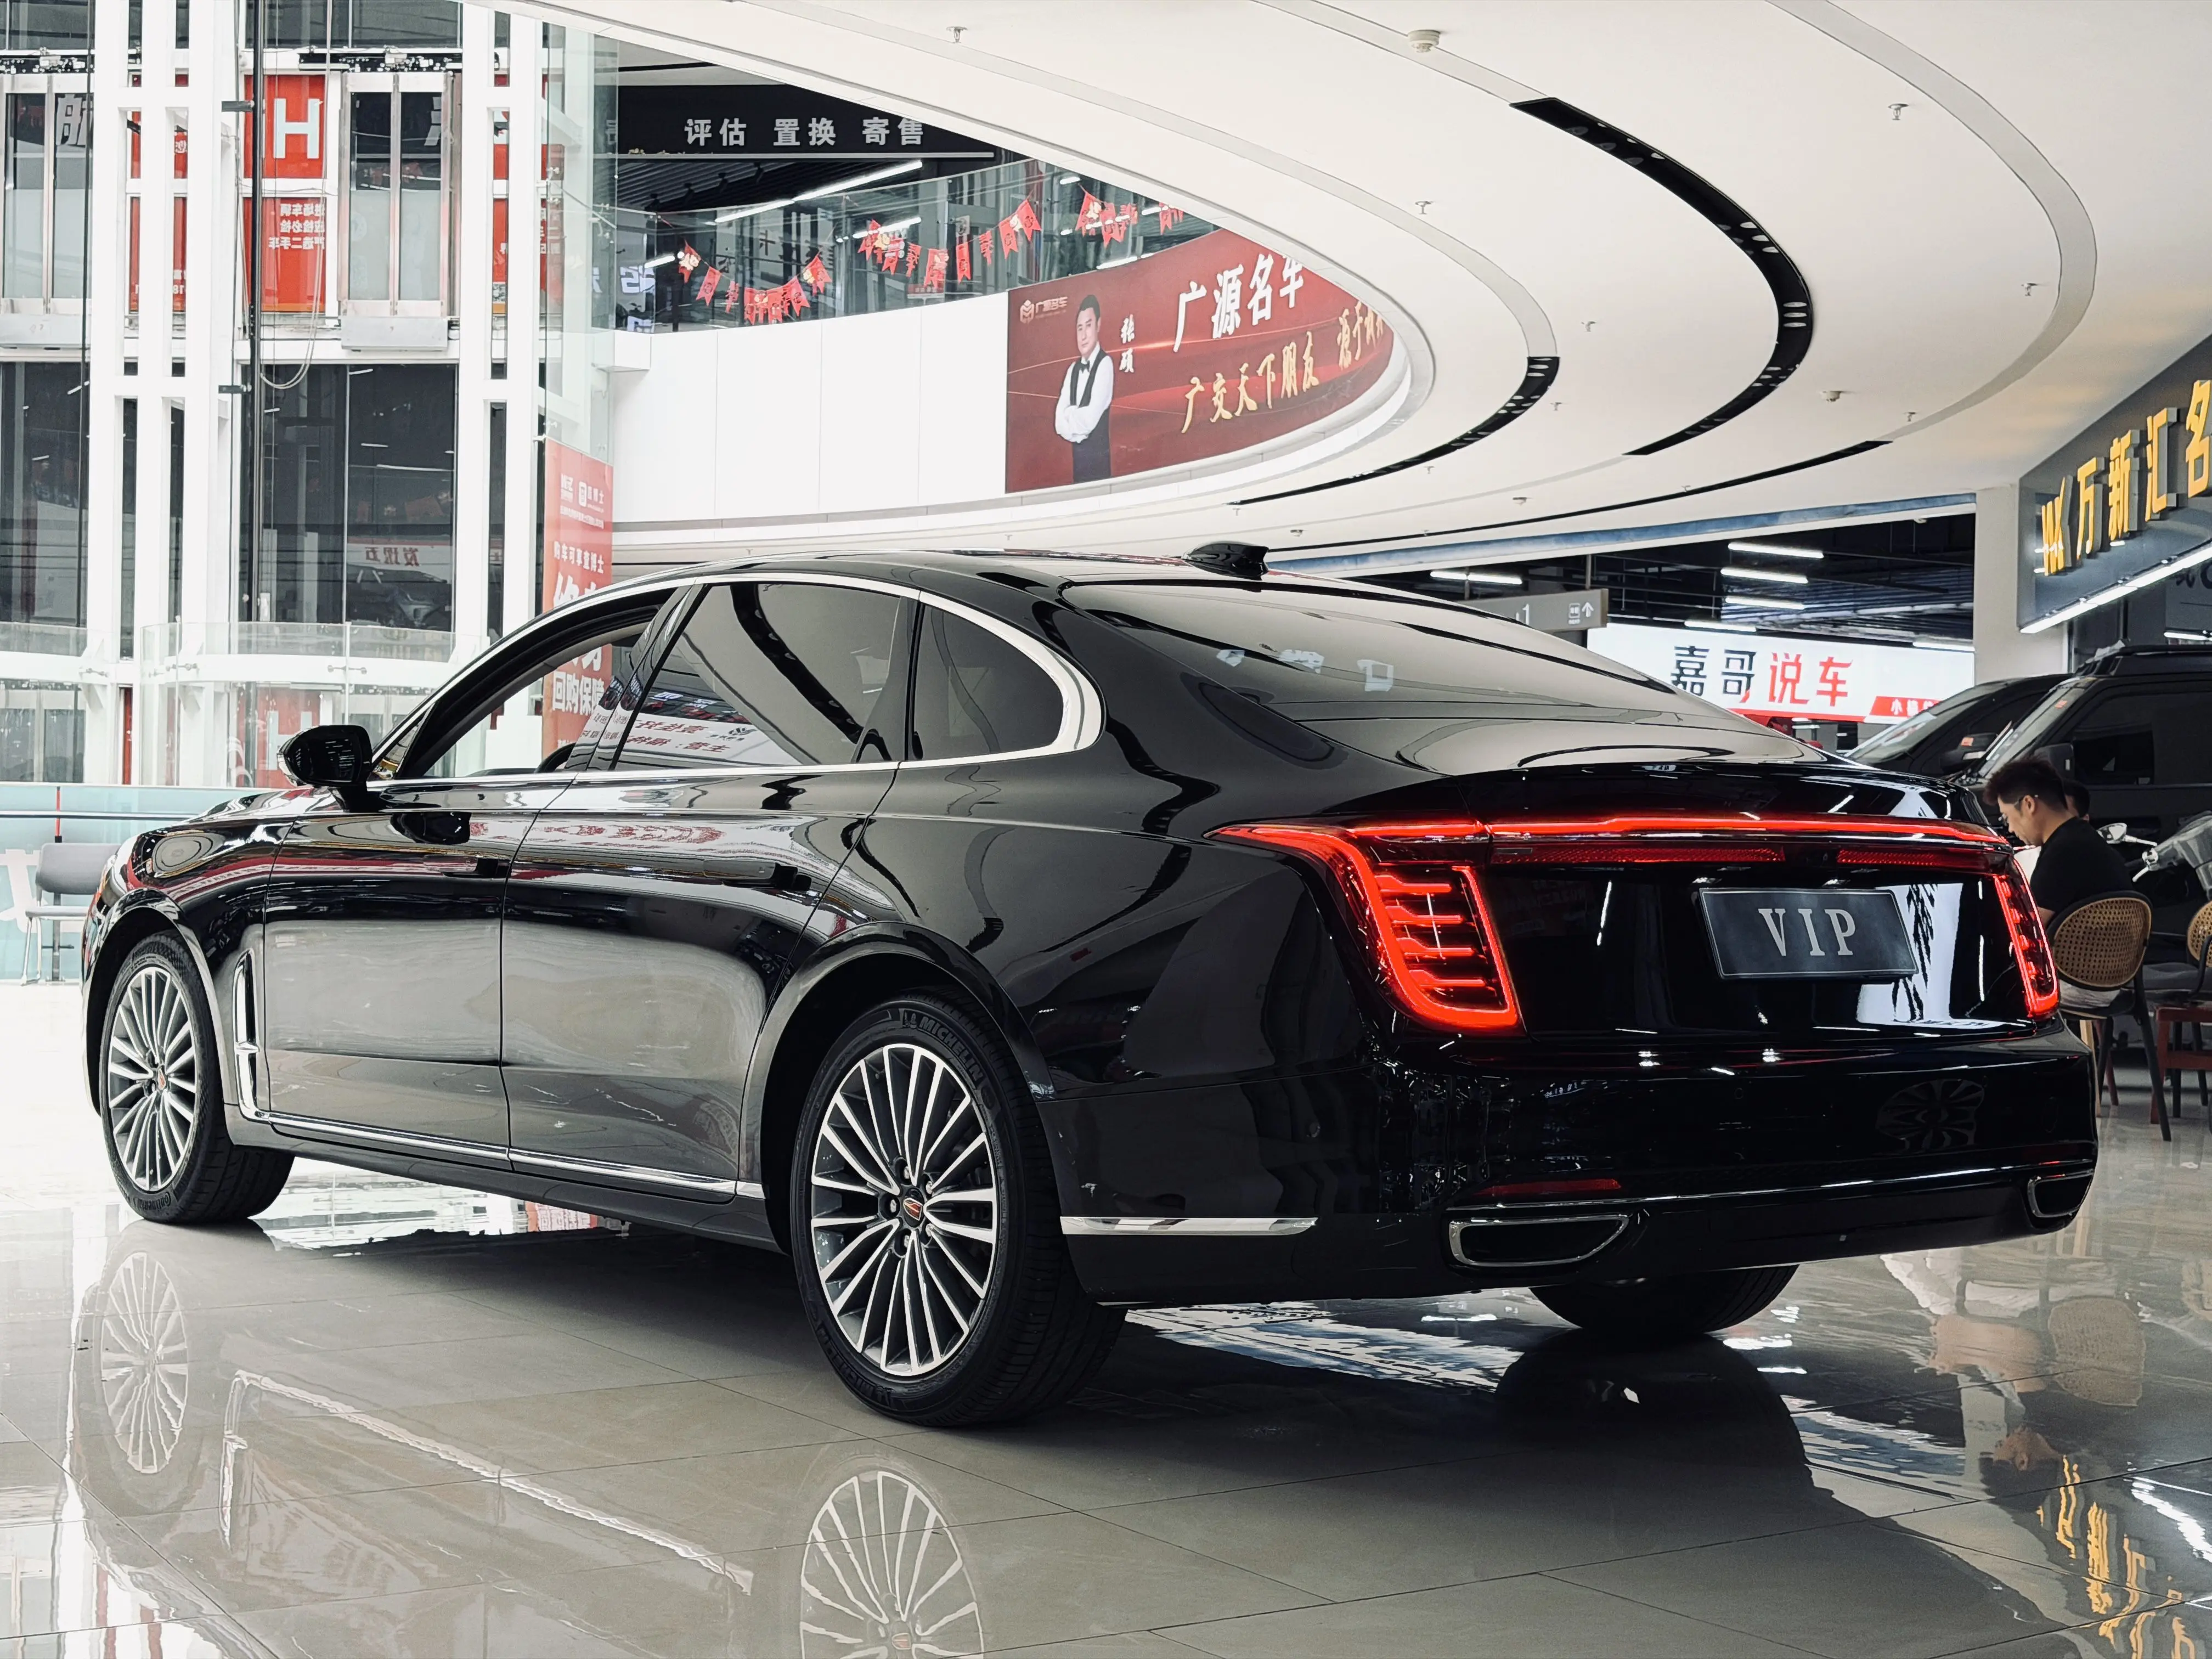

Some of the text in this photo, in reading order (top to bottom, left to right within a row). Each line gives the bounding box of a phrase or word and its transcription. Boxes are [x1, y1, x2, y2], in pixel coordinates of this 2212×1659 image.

[685, 117, 923, 146] 评估 置换 寄售
[1173, 253, 1304, 353] 广源名车
[1181, 331, 1319, 434] 广交天下朋友
[1671, 645, 1854, 707] 嘉哥说车
[1758, 908, 1857, 957] VIP
[918, 1015, 984, 1082] MICHELIN
